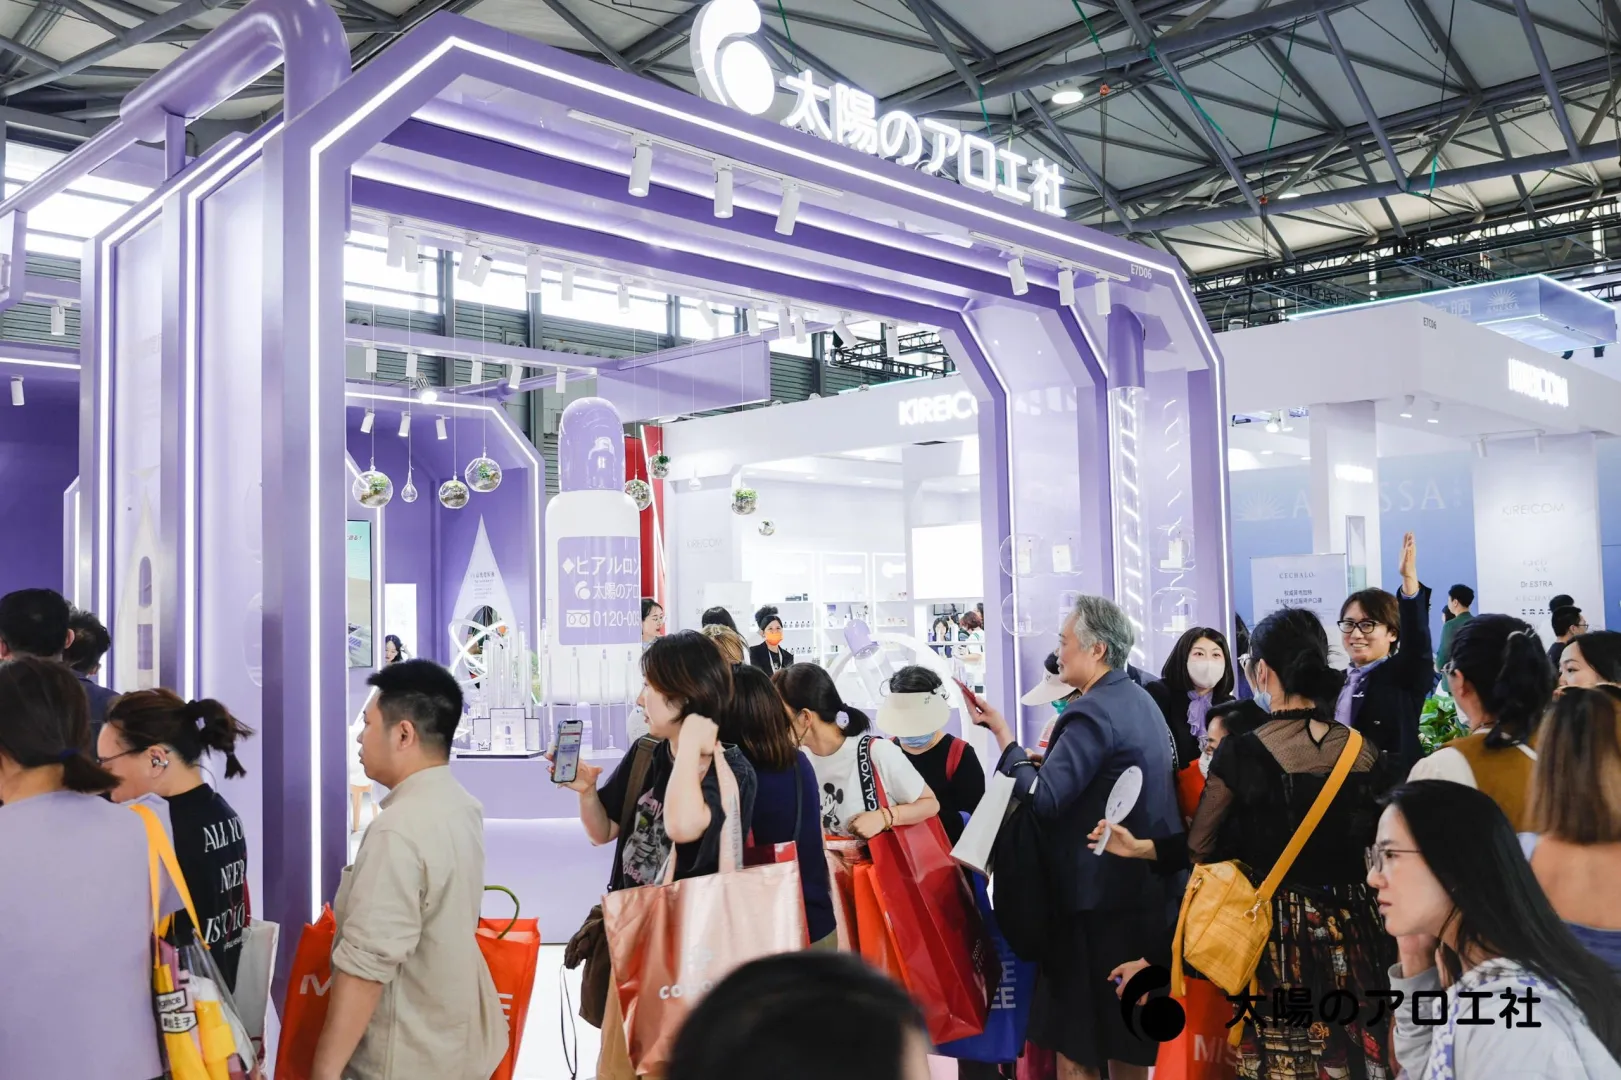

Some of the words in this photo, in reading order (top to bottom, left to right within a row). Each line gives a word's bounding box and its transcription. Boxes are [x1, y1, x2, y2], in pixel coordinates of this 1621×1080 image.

[780, 69, 1067, 217] 太陽のアロエ社
[1130, 263, 1153, 280] E7D06
[203, 821, 229, 853] ALL
